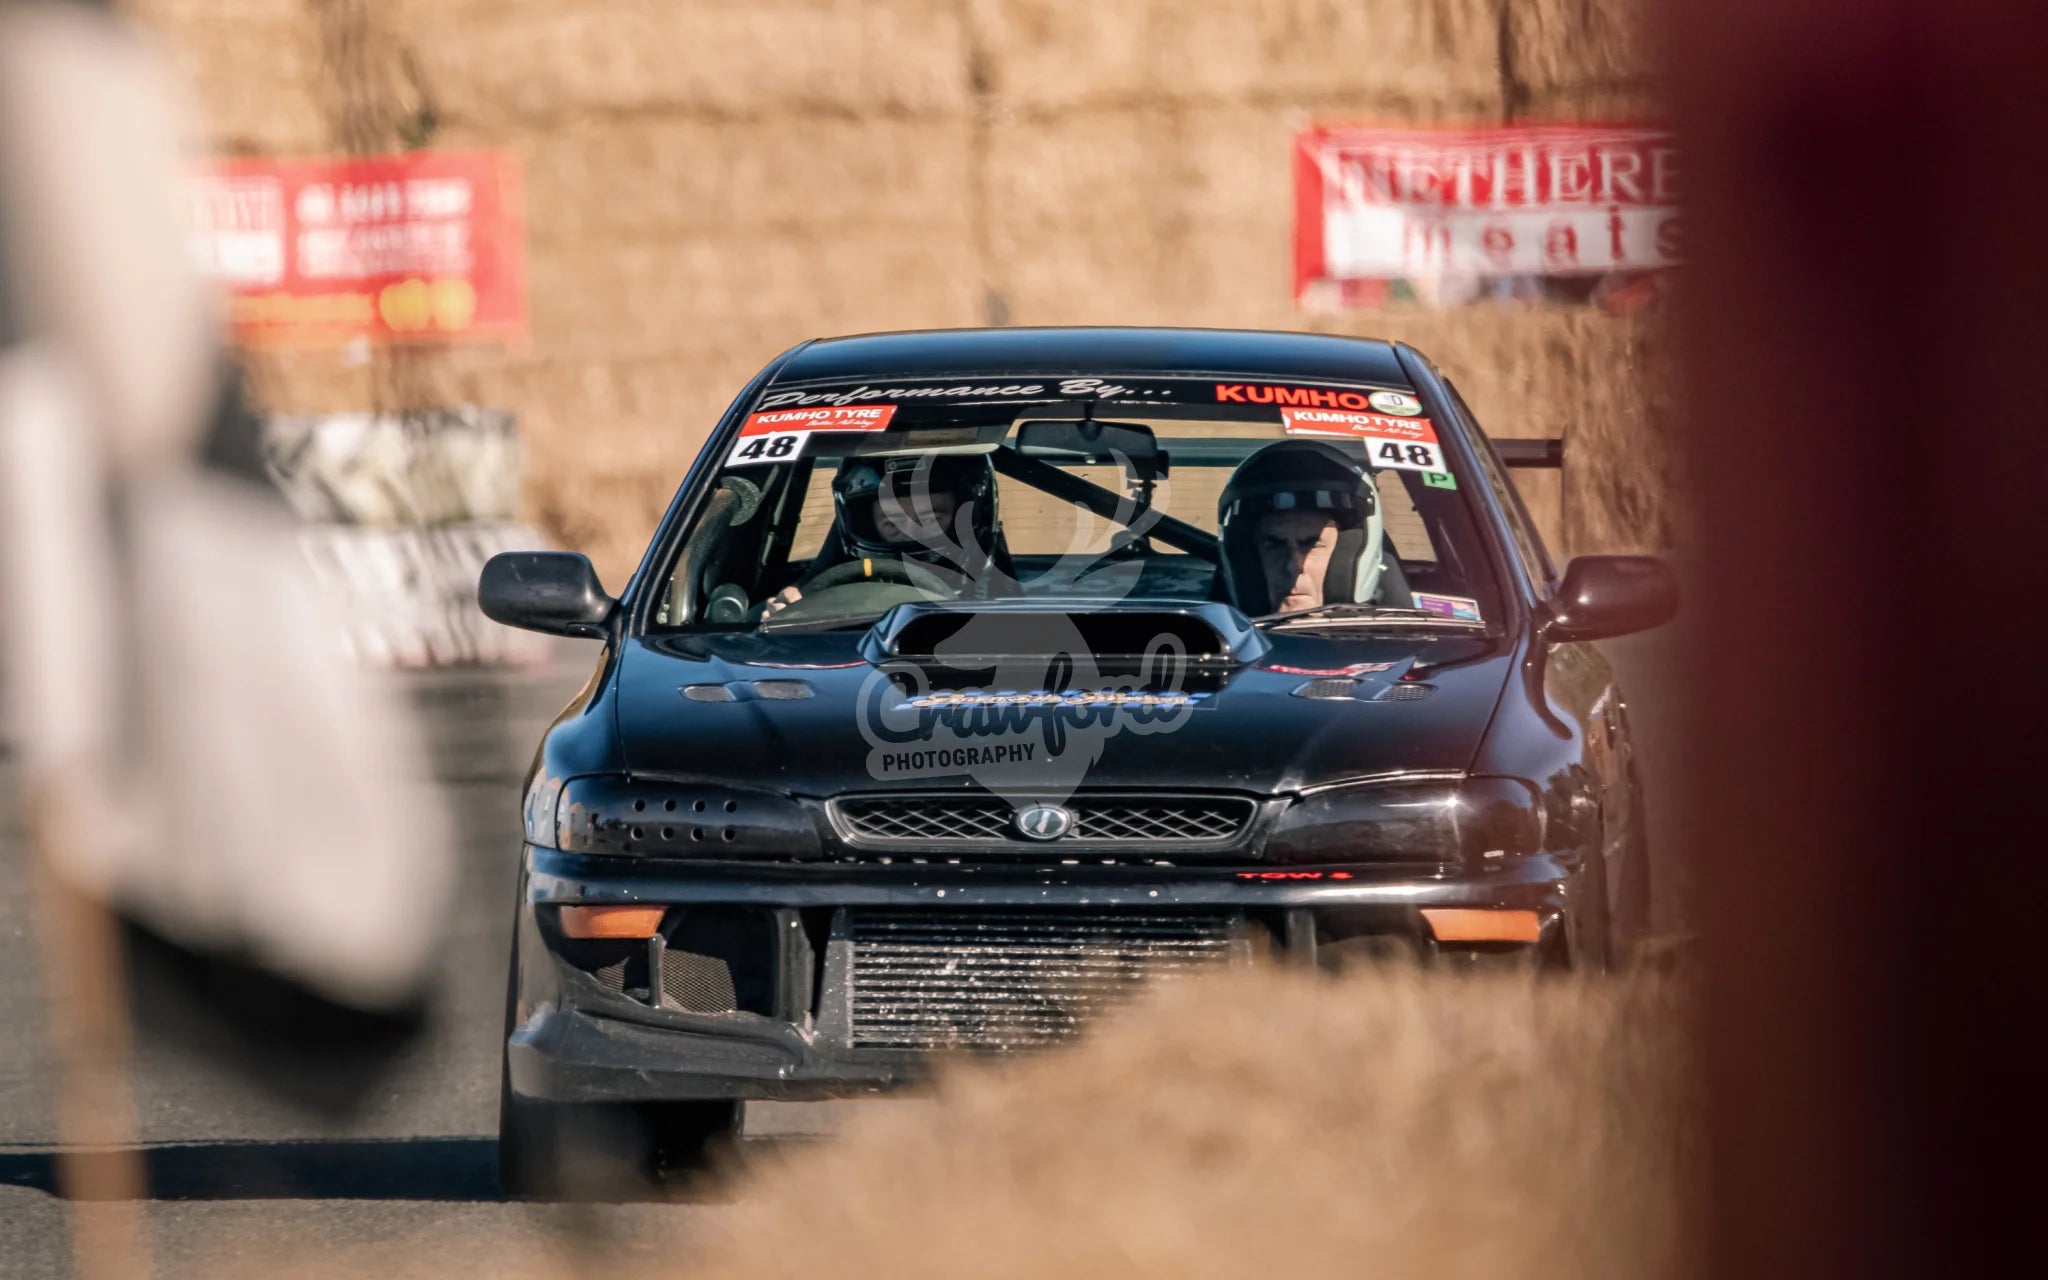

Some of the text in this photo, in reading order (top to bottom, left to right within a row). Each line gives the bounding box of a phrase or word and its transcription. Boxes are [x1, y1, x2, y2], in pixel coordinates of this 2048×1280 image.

[758, 385, 1045, 411] Performance
[1215, 384, 1370, 410] KUMHO
[757, 408, 883, 424] KUMHO TYRE
[1294, 410, 1423, 431] KUMHO TYRE
[737, 435, 799, 461] 48
[1378, 442, 1434, 467] 48
[1427, 473, 1448, 485] P
